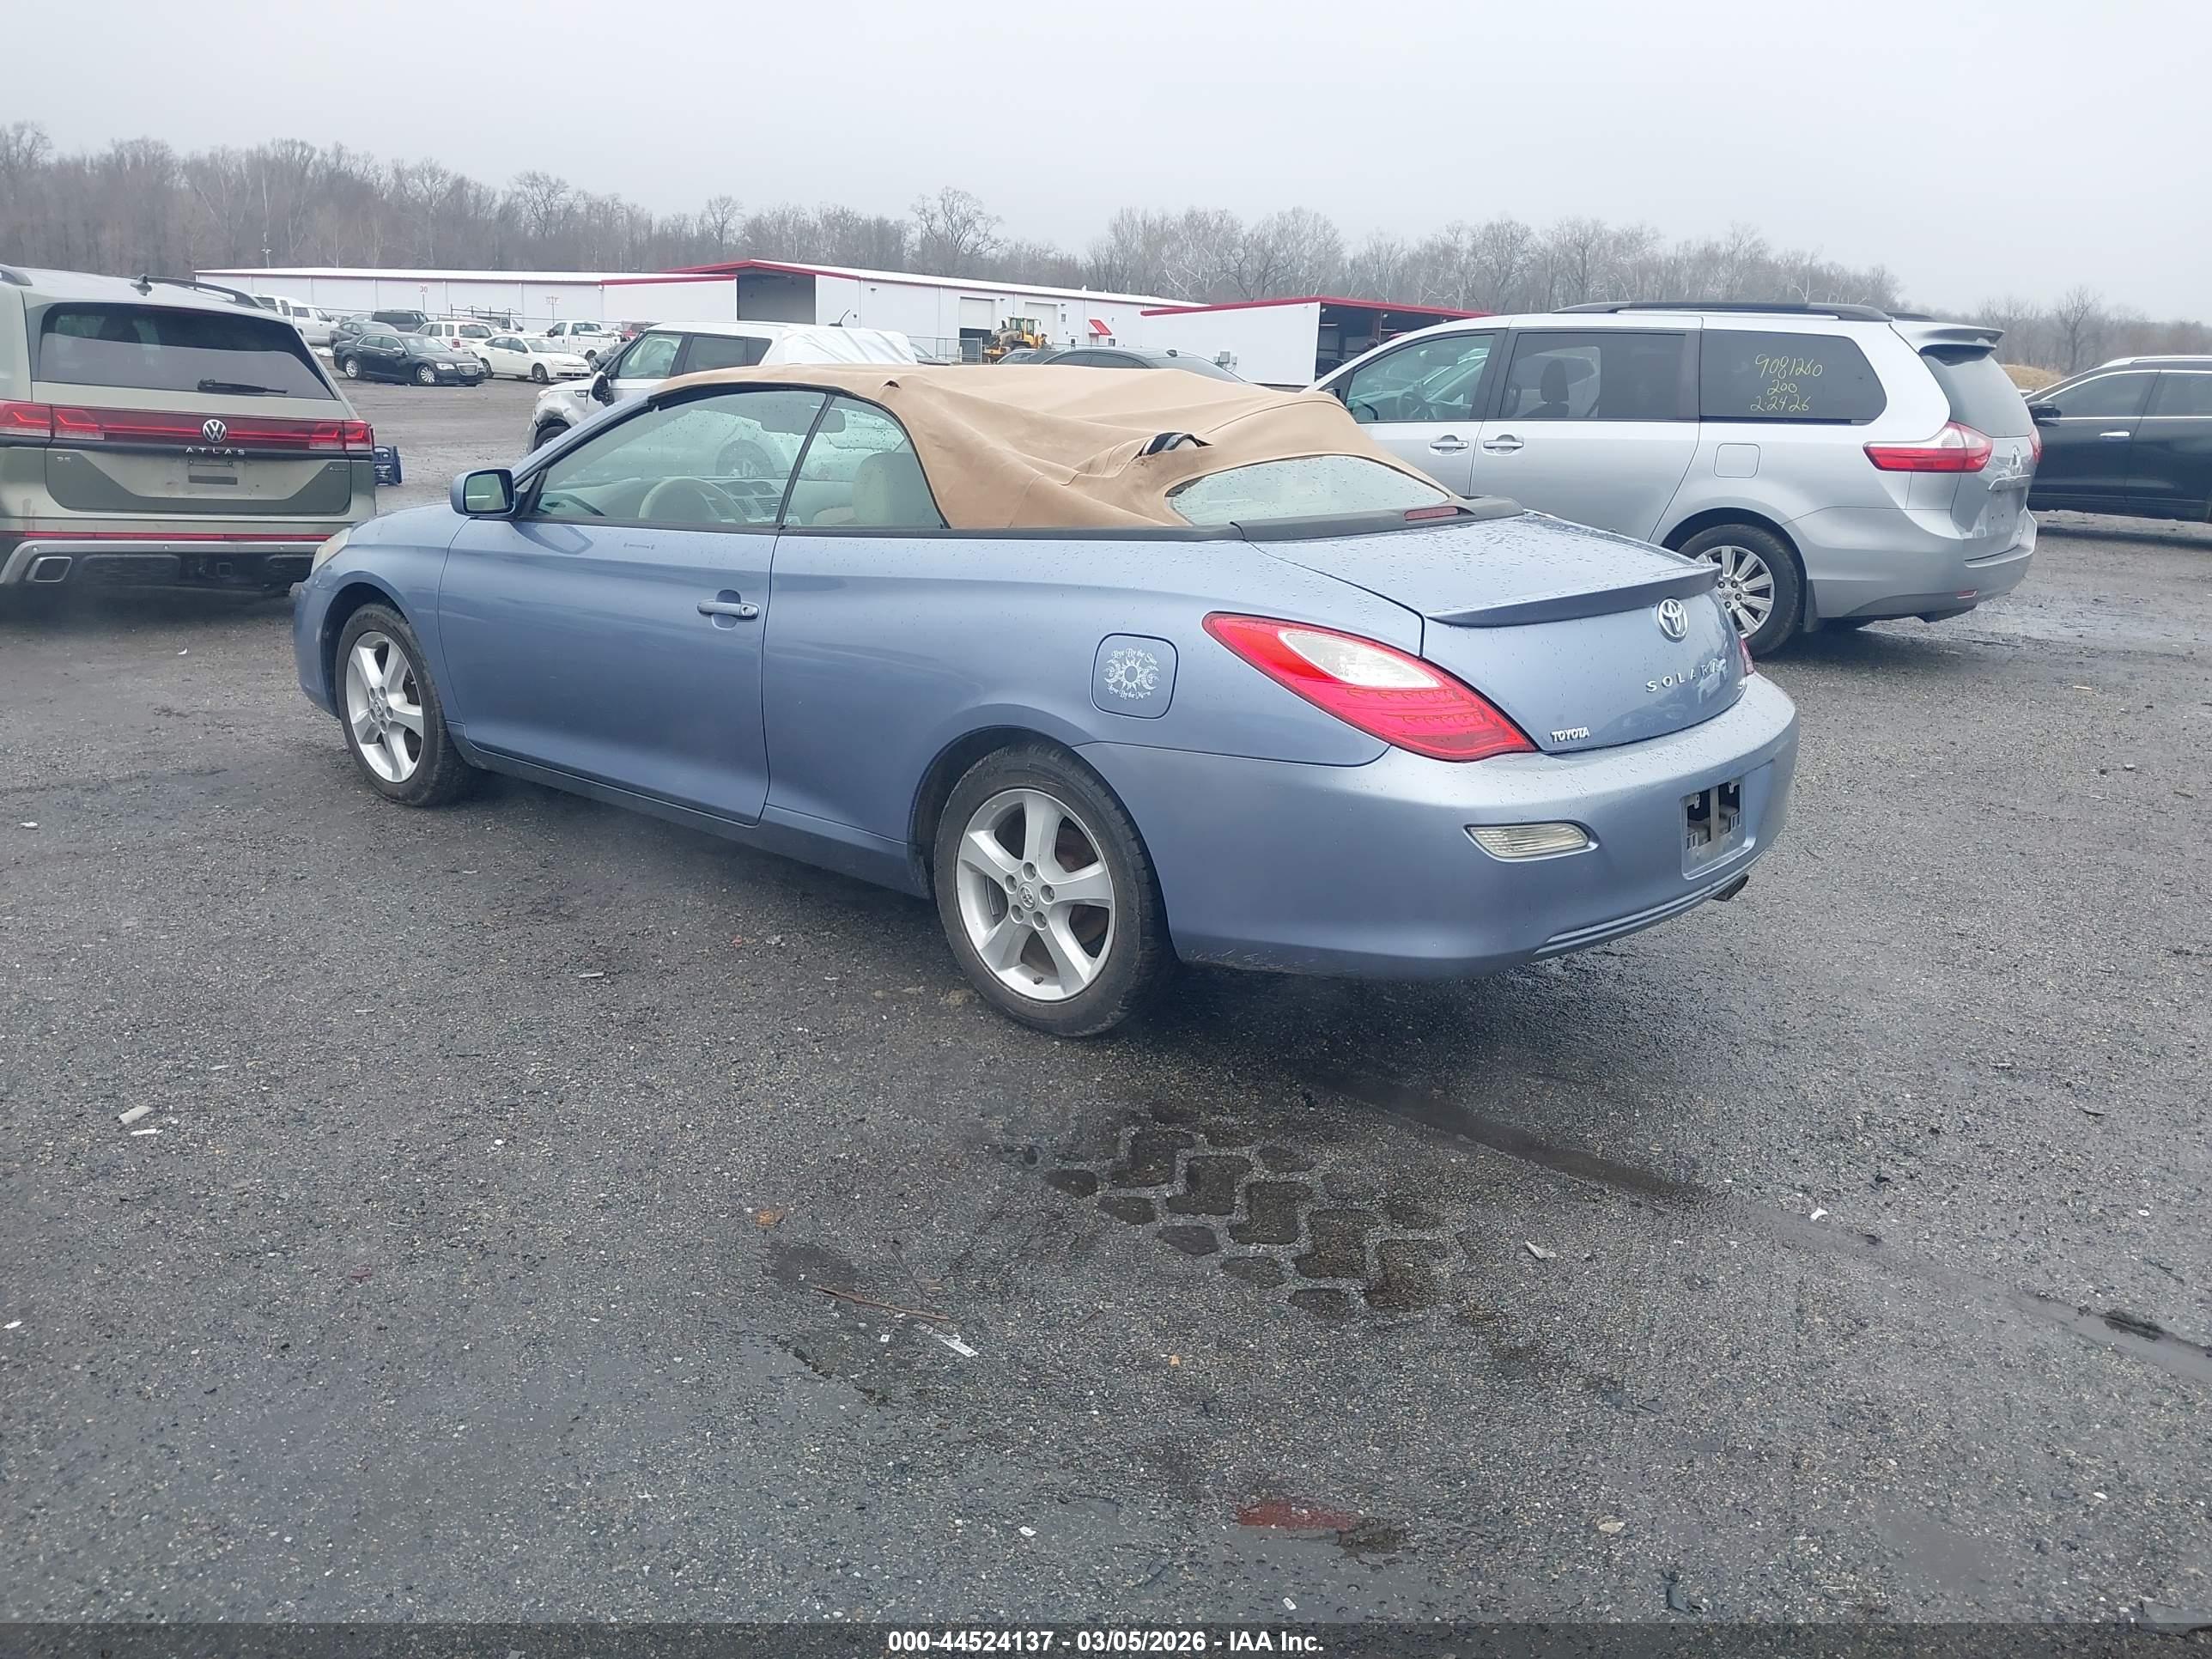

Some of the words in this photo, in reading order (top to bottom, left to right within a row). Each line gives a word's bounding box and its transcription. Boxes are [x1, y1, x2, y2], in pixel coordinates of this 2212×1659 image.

[1755, 354, 1823, 379] 9081260
[1767, 380, 1797, 395] 200
[185, 447, 246, 455] ATLAS
[1551, 727, 1589, 742] TOYOTA
